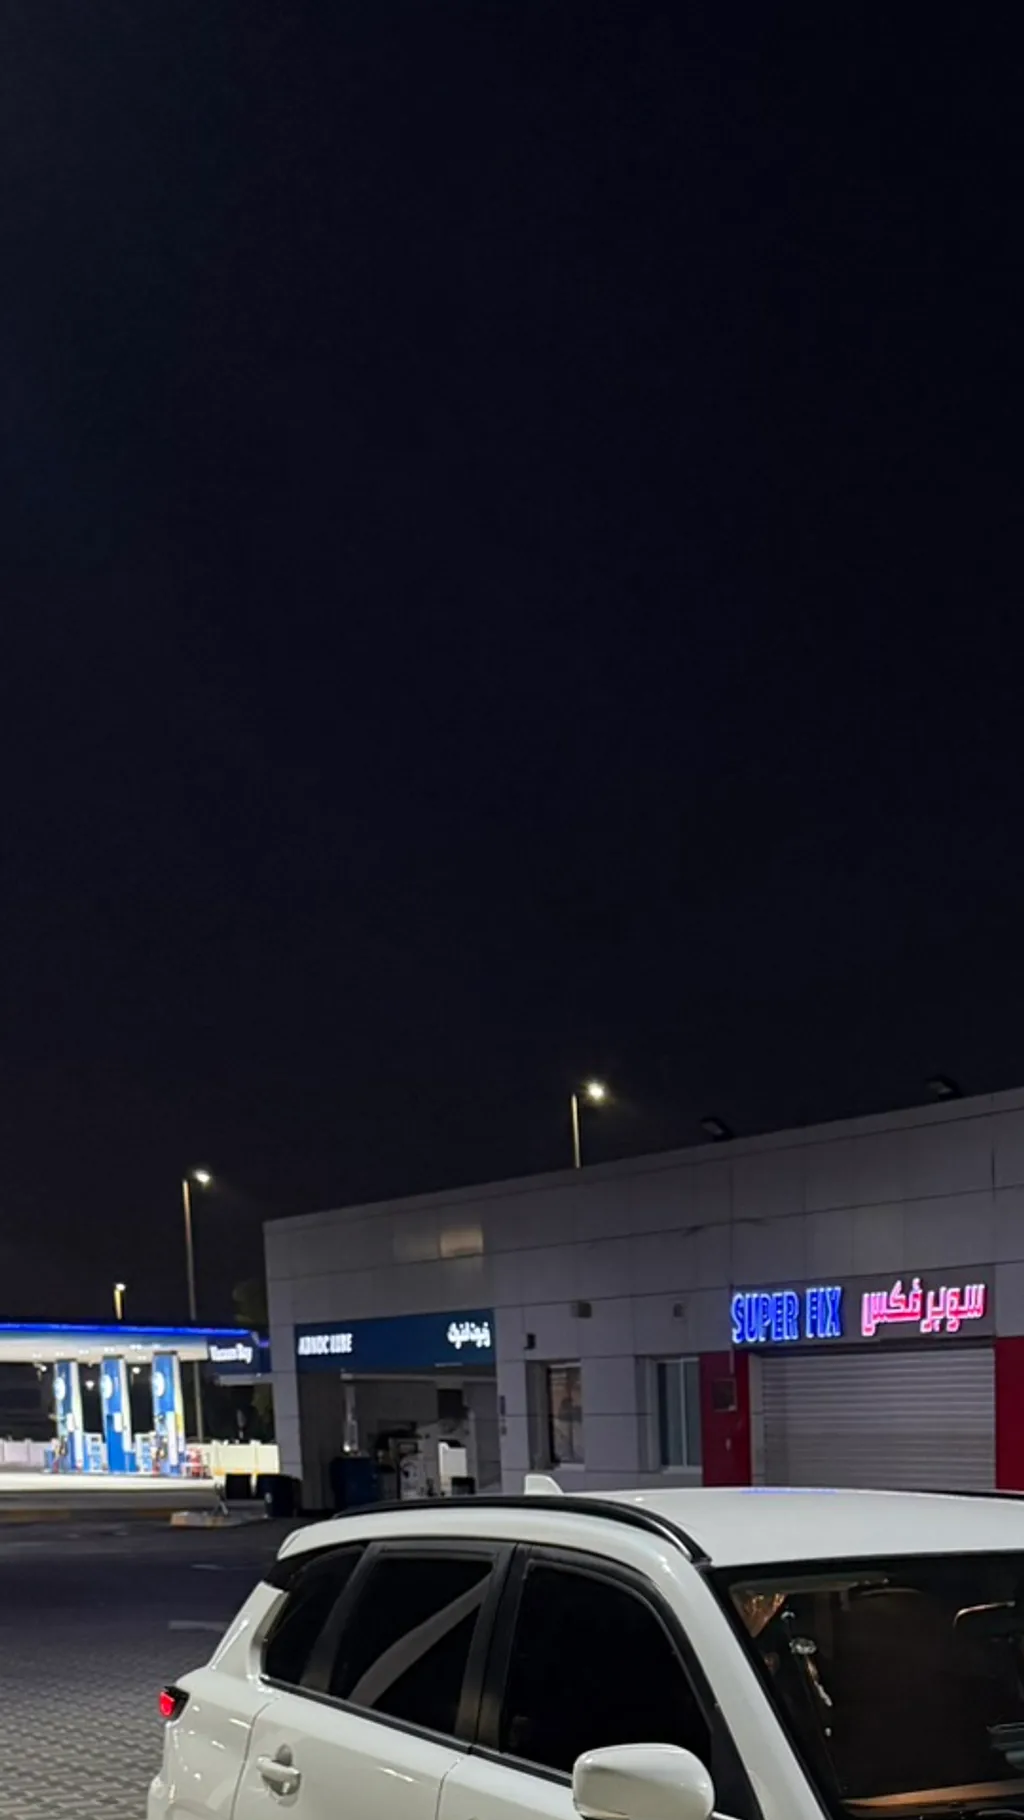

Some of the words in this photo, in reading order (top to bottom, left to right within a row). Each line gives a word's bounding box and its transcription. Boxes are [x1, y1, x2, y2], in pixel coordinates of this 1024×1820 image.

[730, 1291, 799, 1344] SUPER
[805, 1286, 842, 1338] FIX
[862, 1277, 922, 1336] فكس
[919, 1283, 985, 1333] سوبر
